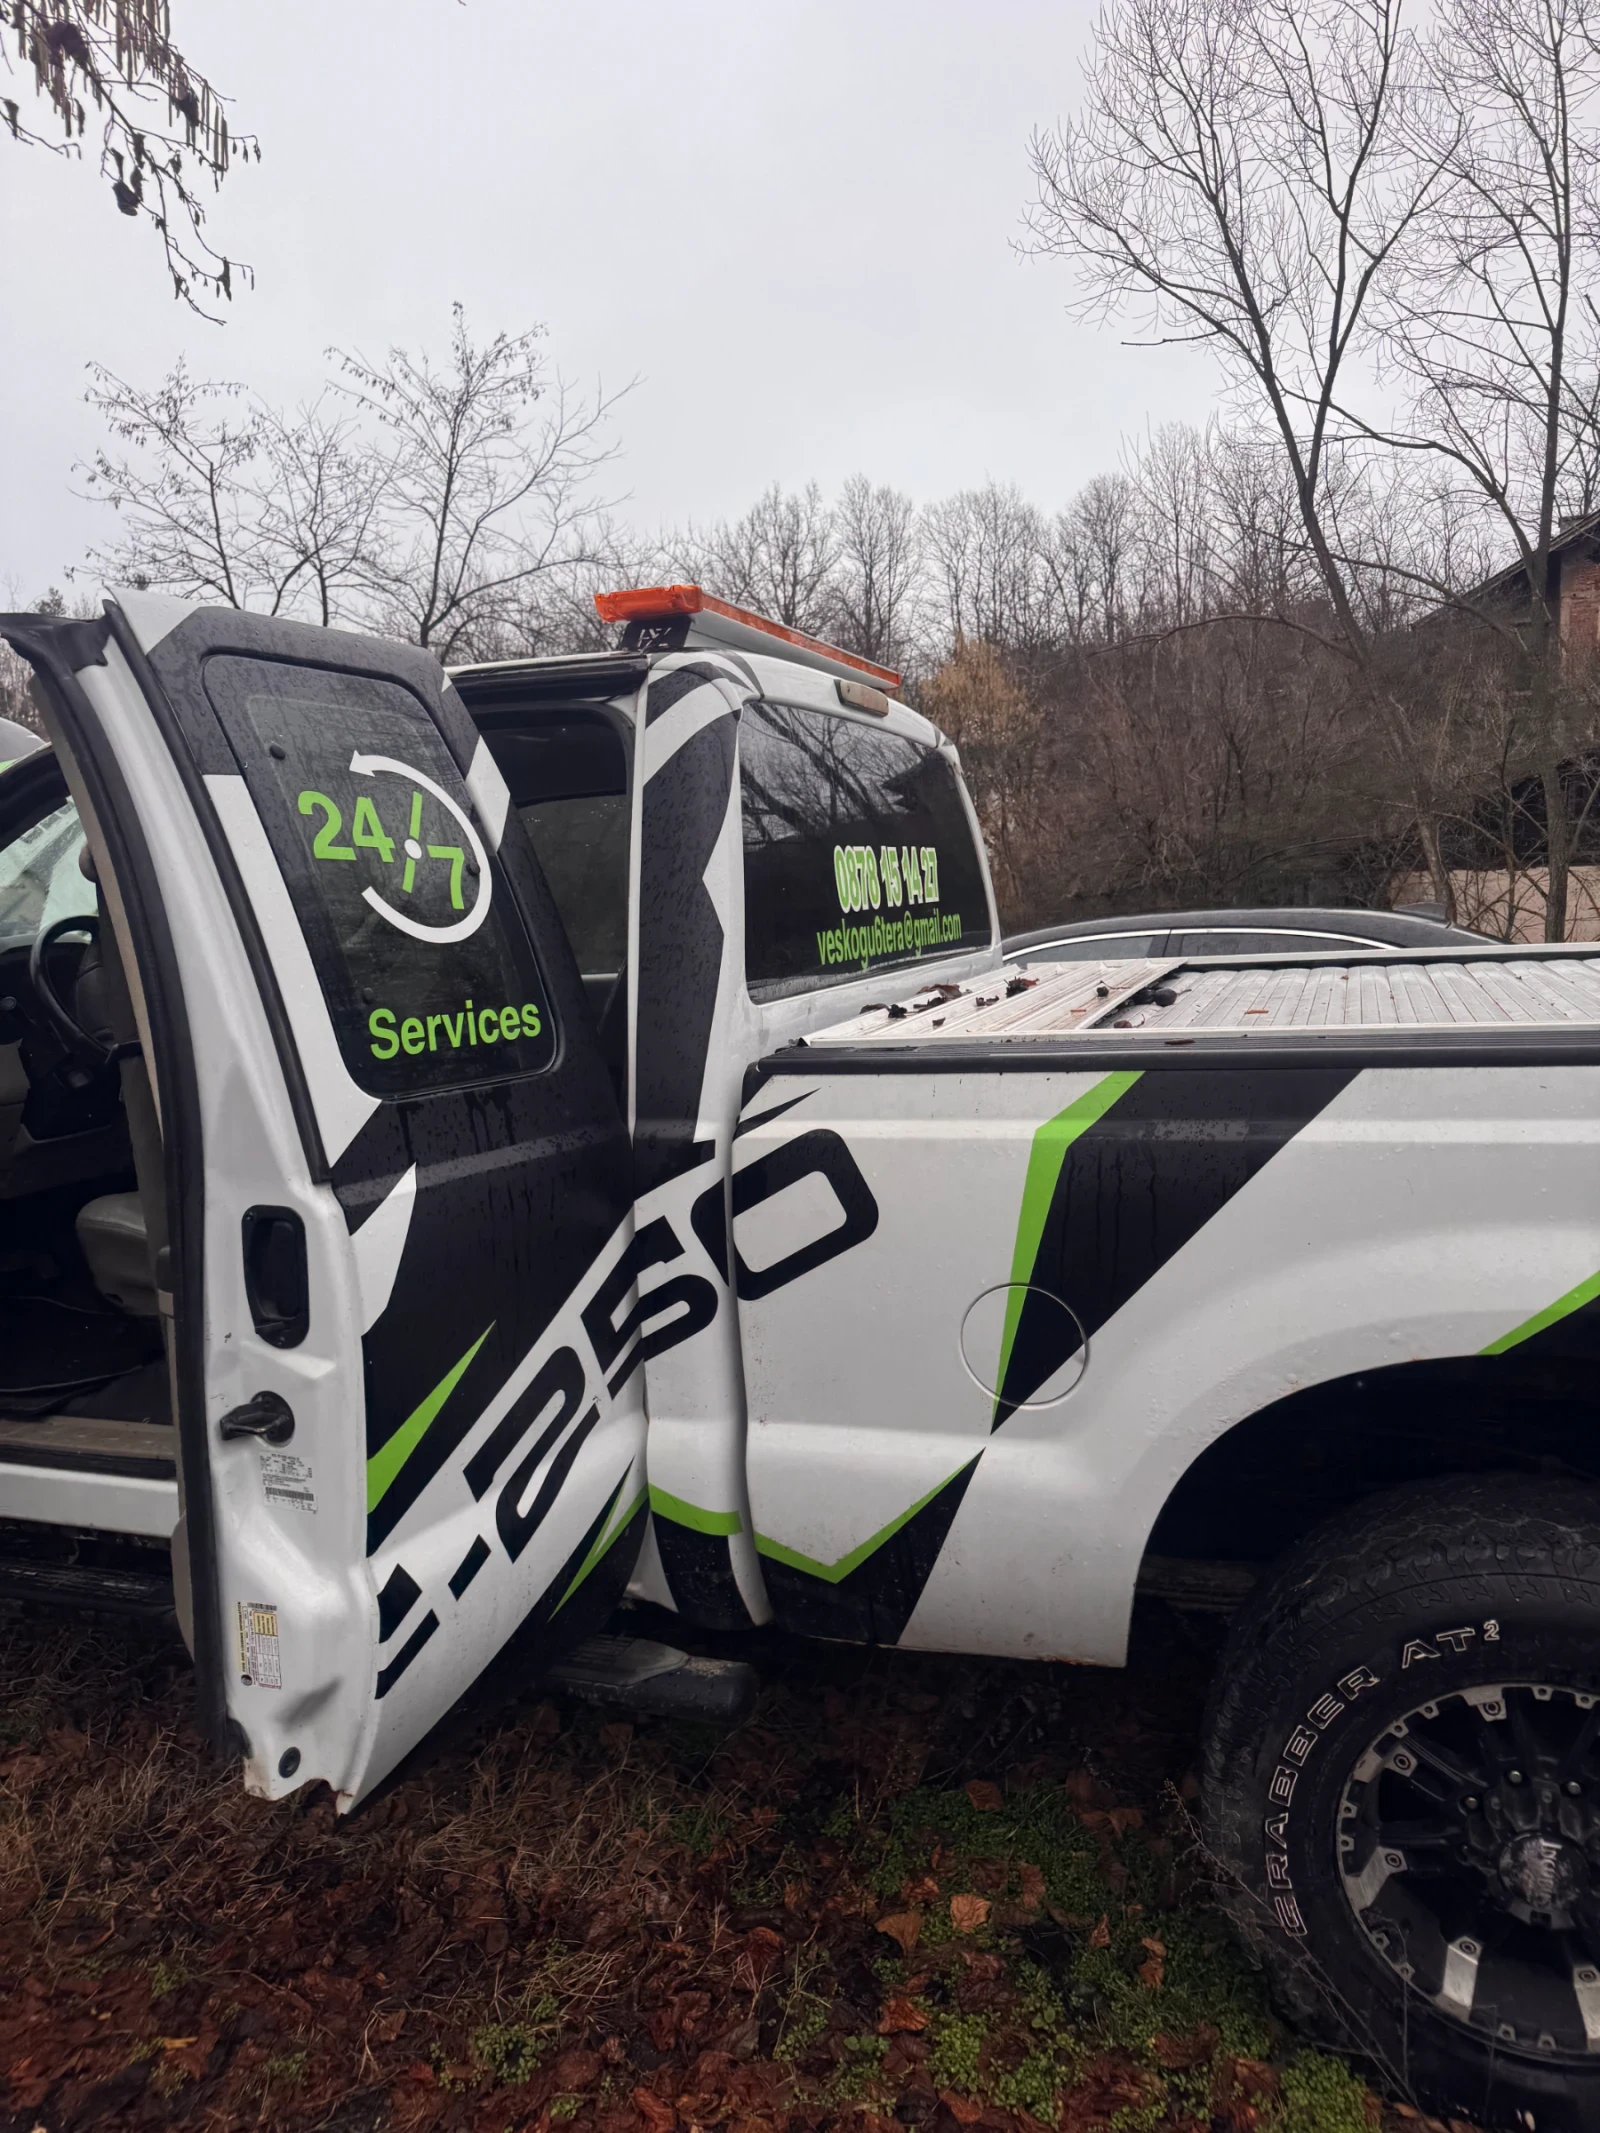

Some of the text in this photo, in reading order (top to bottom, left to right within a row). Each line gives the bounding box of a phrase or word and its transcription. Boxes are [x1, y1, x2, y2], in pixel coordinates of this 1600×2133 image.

[298, 790, 465, 910] 24/7
[833, 845, 939, 913] 0878 15 14 27
[816, 908, 962, 969] veskogu6tera@gmail.com
[368, 999, 542, 1060] Services
[1264, 1666, 1381, 1937] GRABBER
